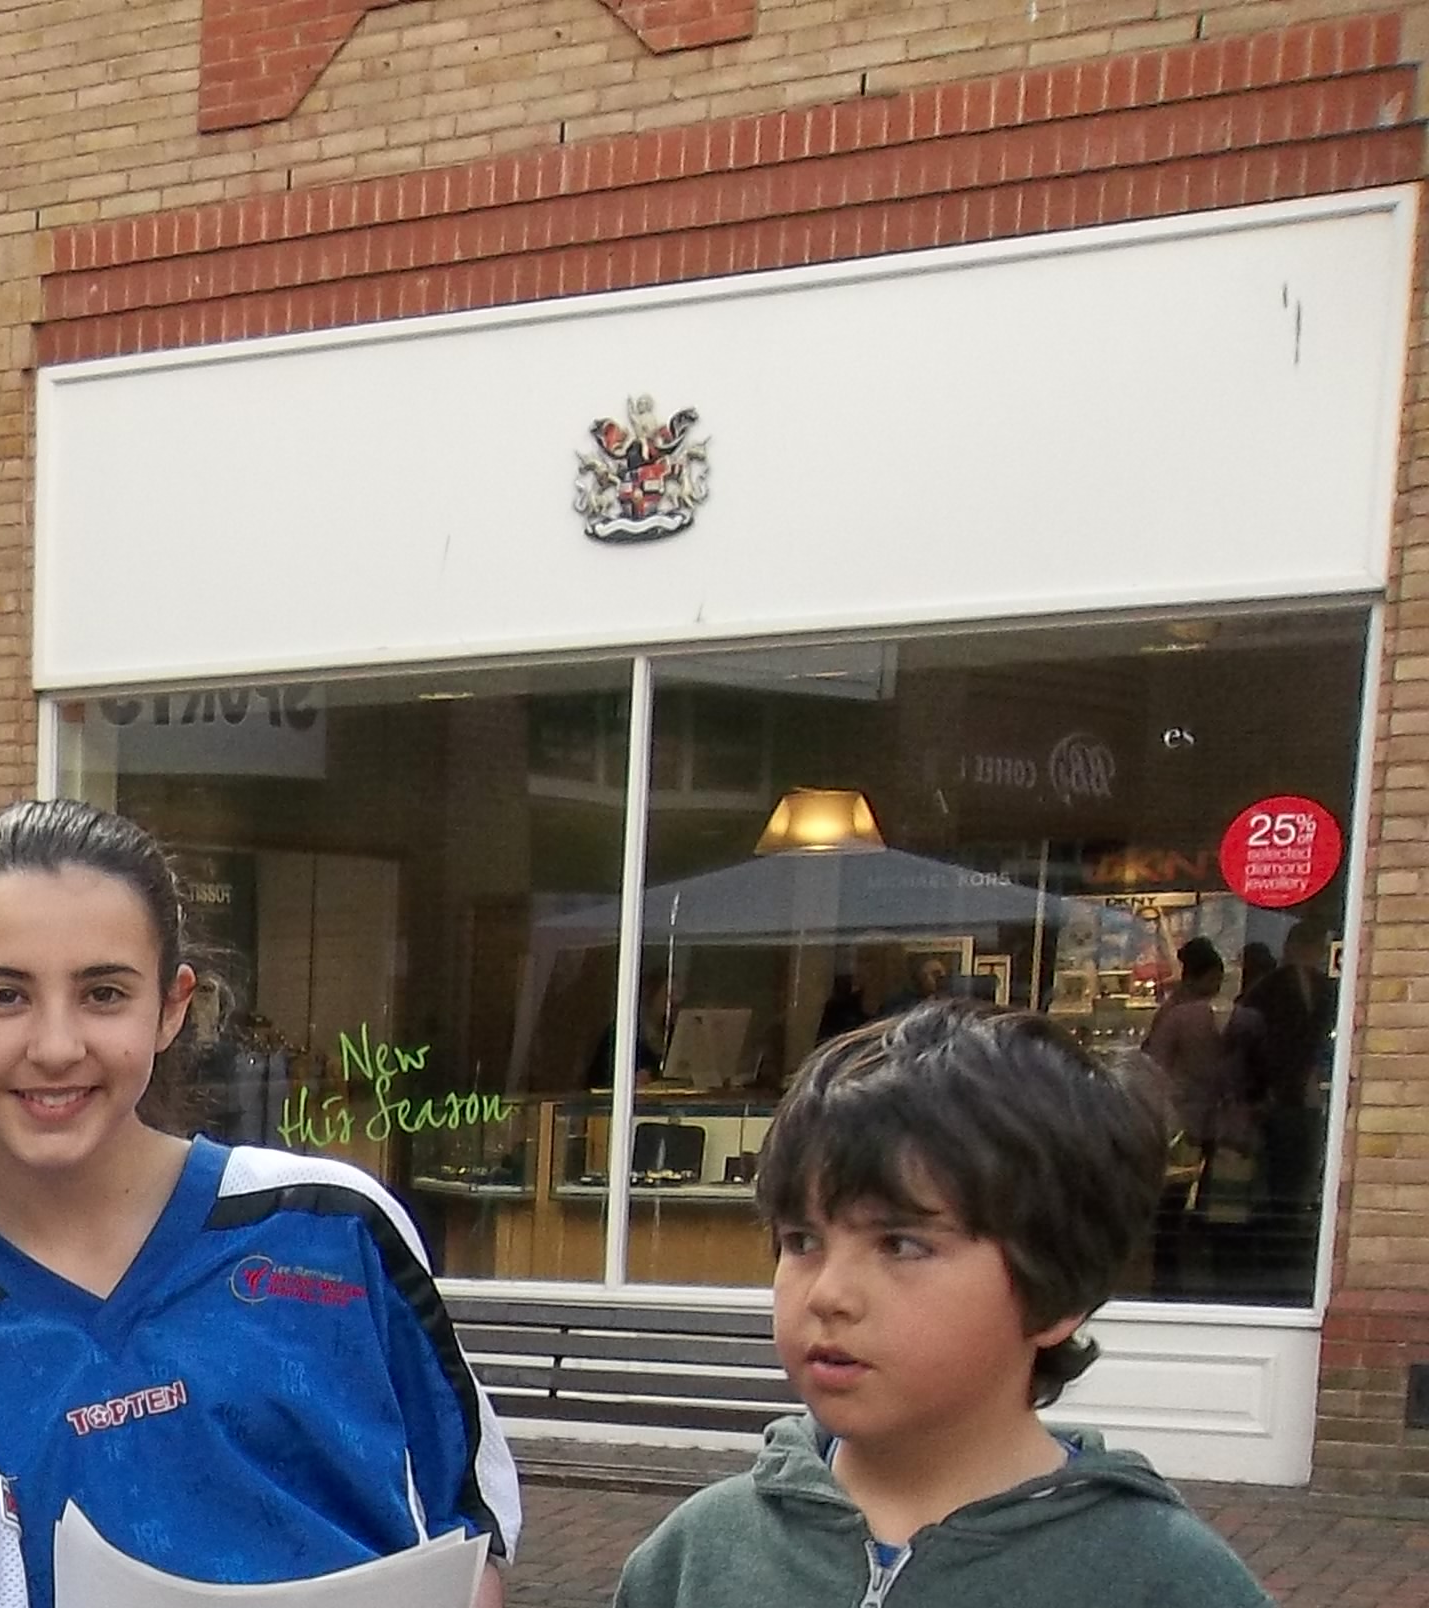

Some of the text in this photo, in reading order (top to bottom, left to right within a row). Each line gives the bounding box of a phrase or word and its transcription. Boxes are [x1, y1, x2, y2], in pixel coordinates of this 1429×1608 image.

[1245, 861, 1311, 875] diamond
[188, 882, 233, 904] TISSOT
[341, 1021, 431, 1081] New
